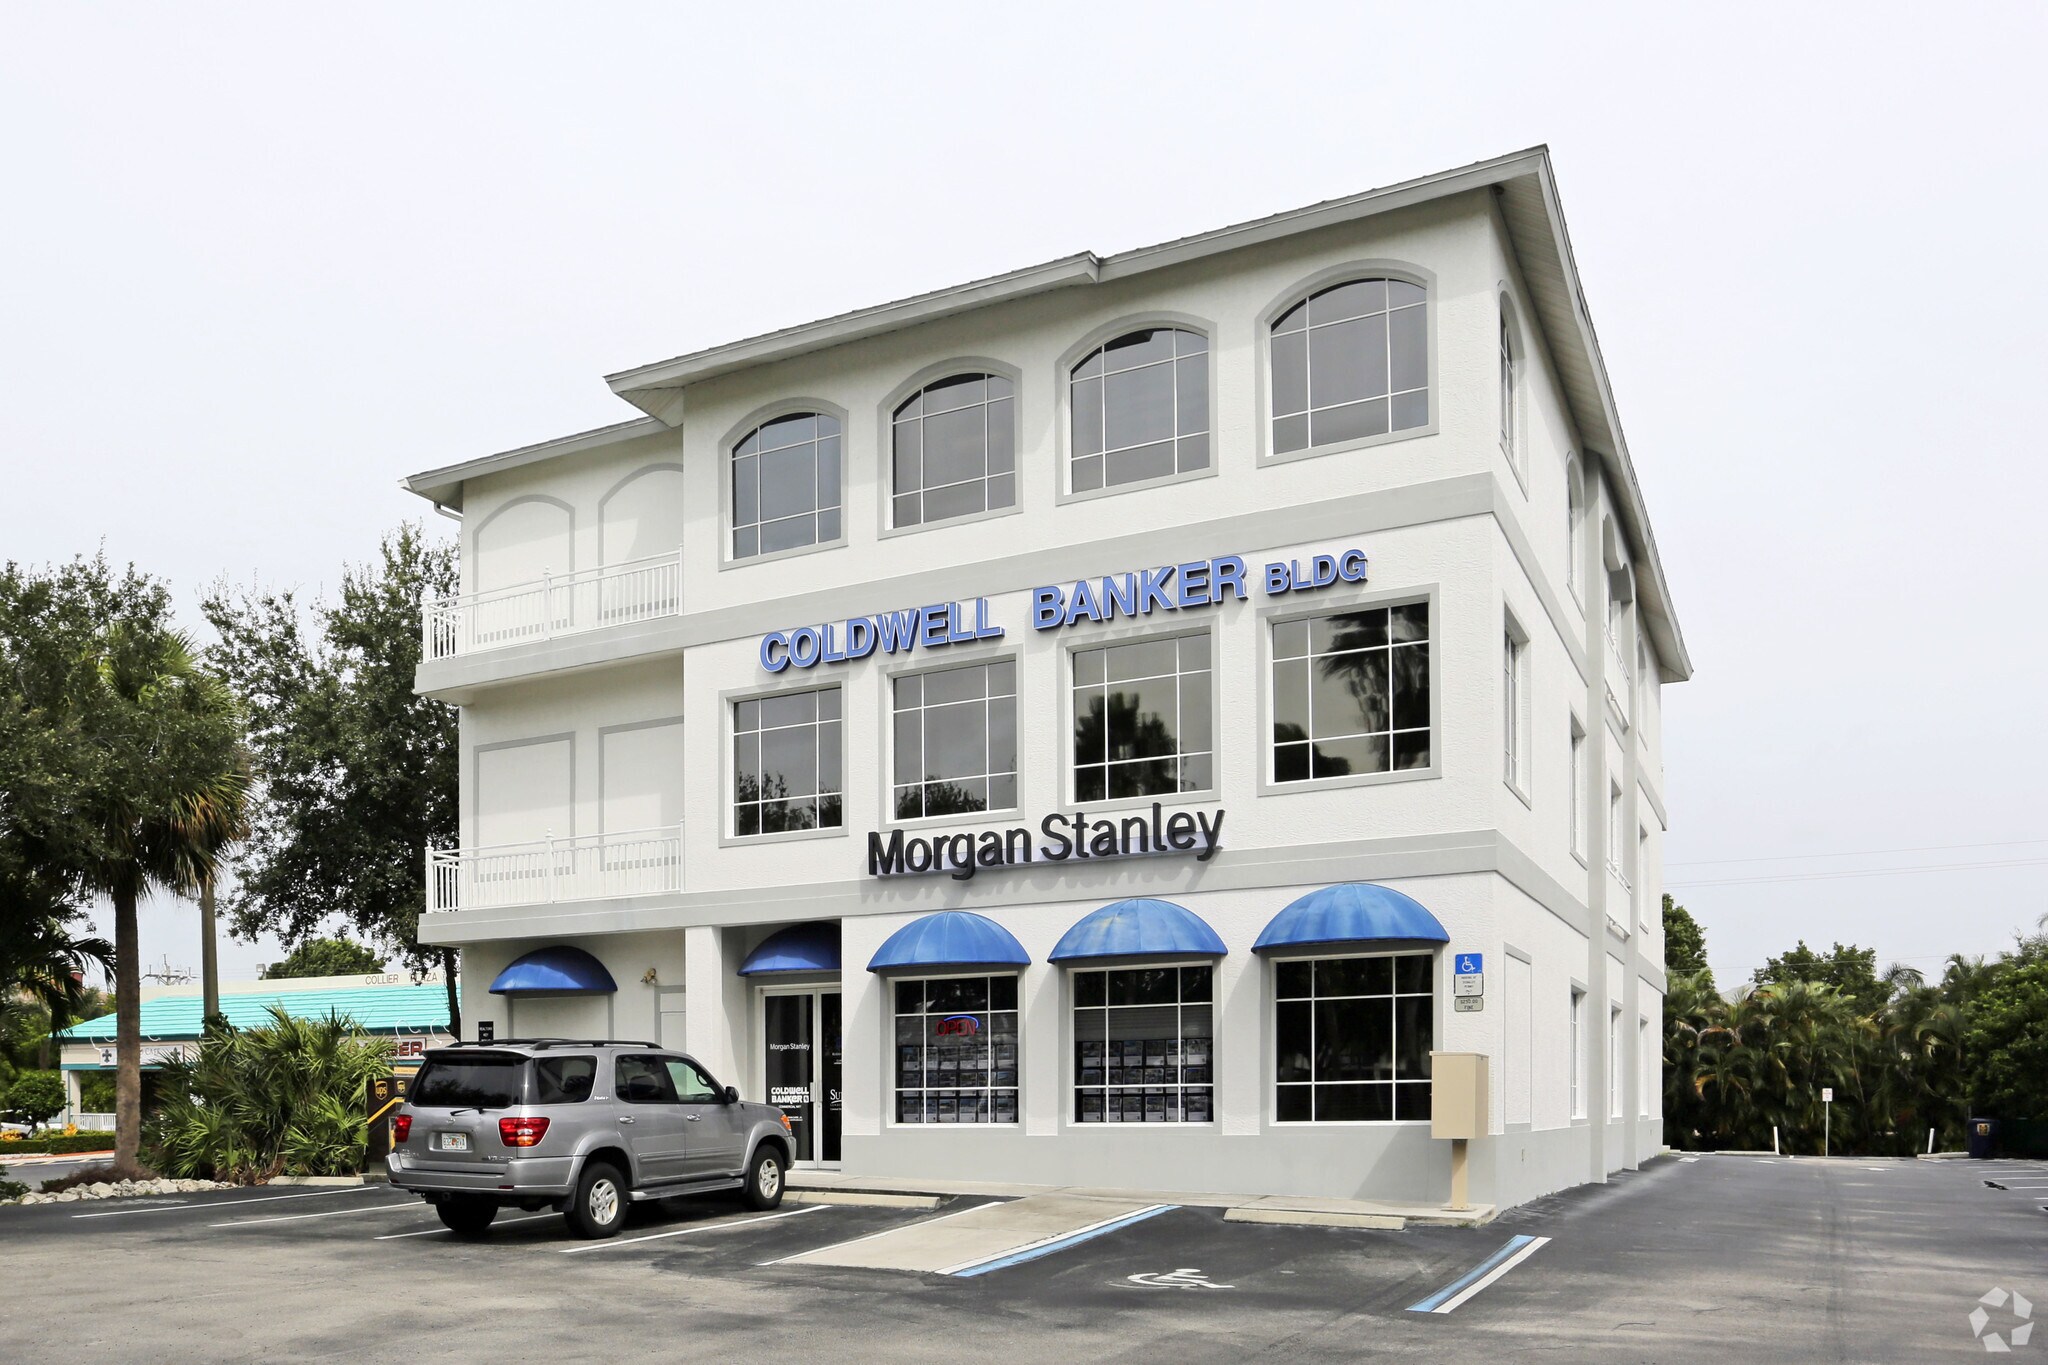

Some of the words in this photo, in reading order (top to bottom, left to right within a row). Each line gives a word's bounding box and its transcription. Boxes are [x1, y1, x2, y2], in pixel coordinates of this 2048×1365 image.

[759, 597, 1005, 673] COLDWELL
[1032, 554, 1248, 631] BANKER
[1264, 549, 1367, 595] BLDG
[868, 829, 1032, 880] Morgan
[1040, 802, 1225, 861] Stanley
[365, 974, 399, 985] COLLIER
[936, 1019, 976, 1036] OPEN
[770, 1043, 789, 1051] Morgan
